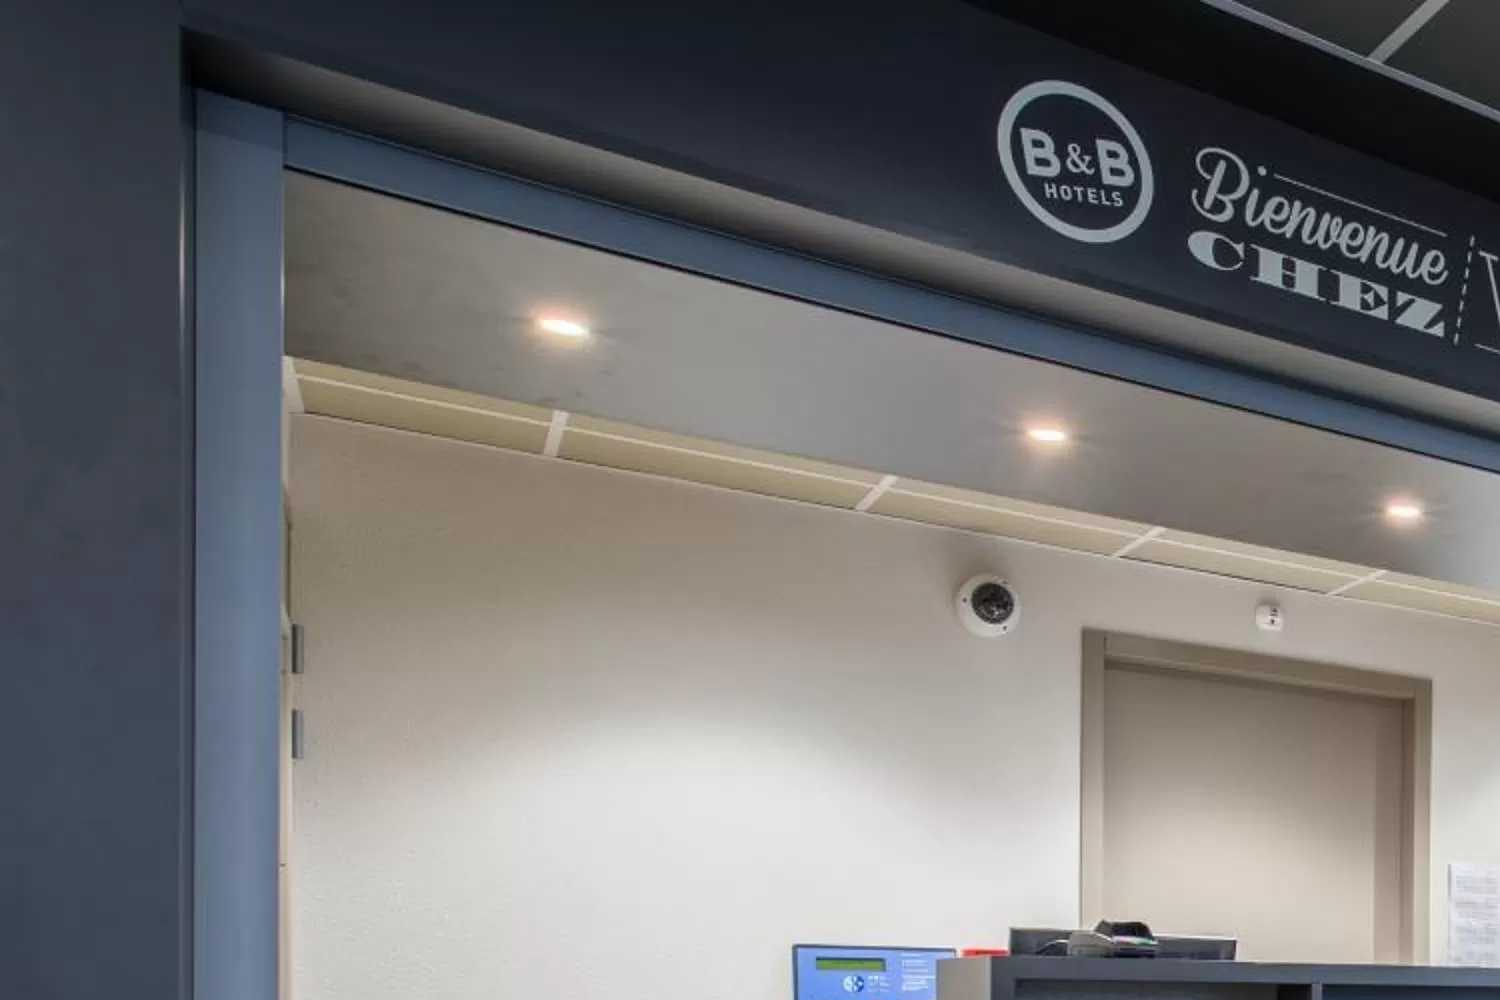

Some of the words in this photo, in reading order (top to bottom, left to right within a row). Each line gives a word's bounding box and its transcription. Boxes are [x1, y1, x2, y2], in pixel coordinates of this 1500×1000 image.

[1019, 127, 1136, 187] B&B
[1043, 182, 1124, 207] HOTELS
[1191, 147, 1448, 286] Bienvenue
[1187, 230, 1445, 338] CHEZ
